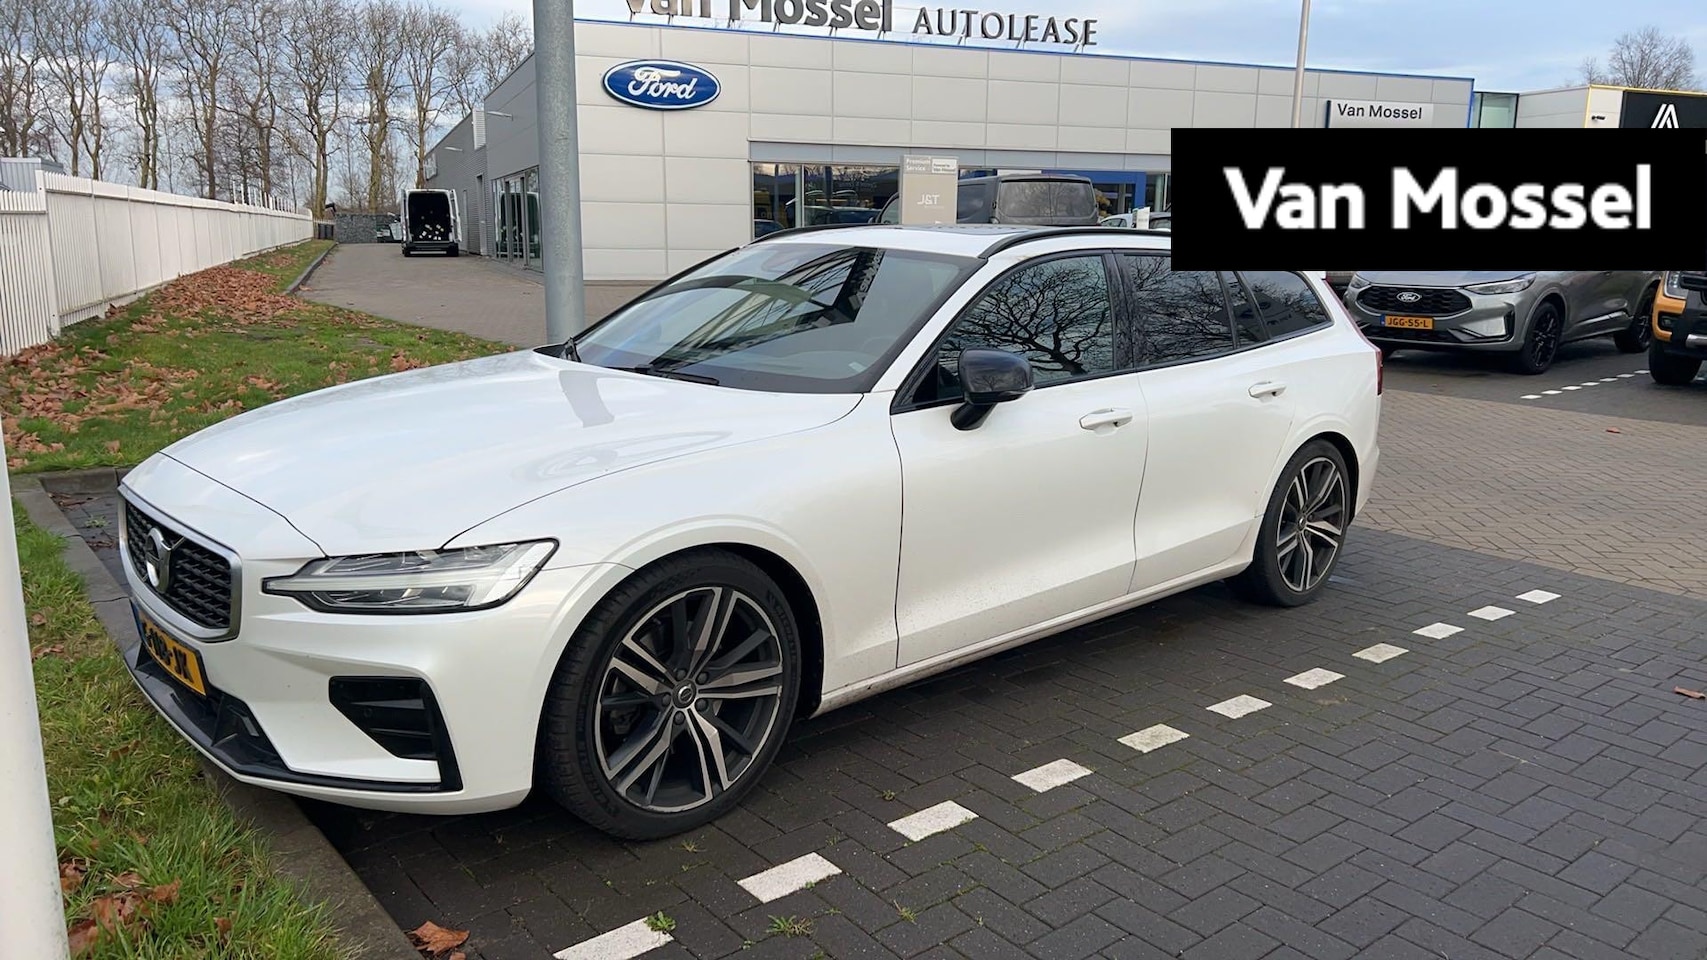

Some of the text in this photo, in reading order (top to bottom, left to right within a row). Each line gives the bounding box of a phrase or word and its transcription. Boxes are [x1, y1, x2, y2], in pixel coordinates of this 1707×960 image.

[912, 6, 1097, 46] AUTOLEASE
[627, 66, 698, 99] Ford
[1337, 103, 1422, 119] Van Mossel
